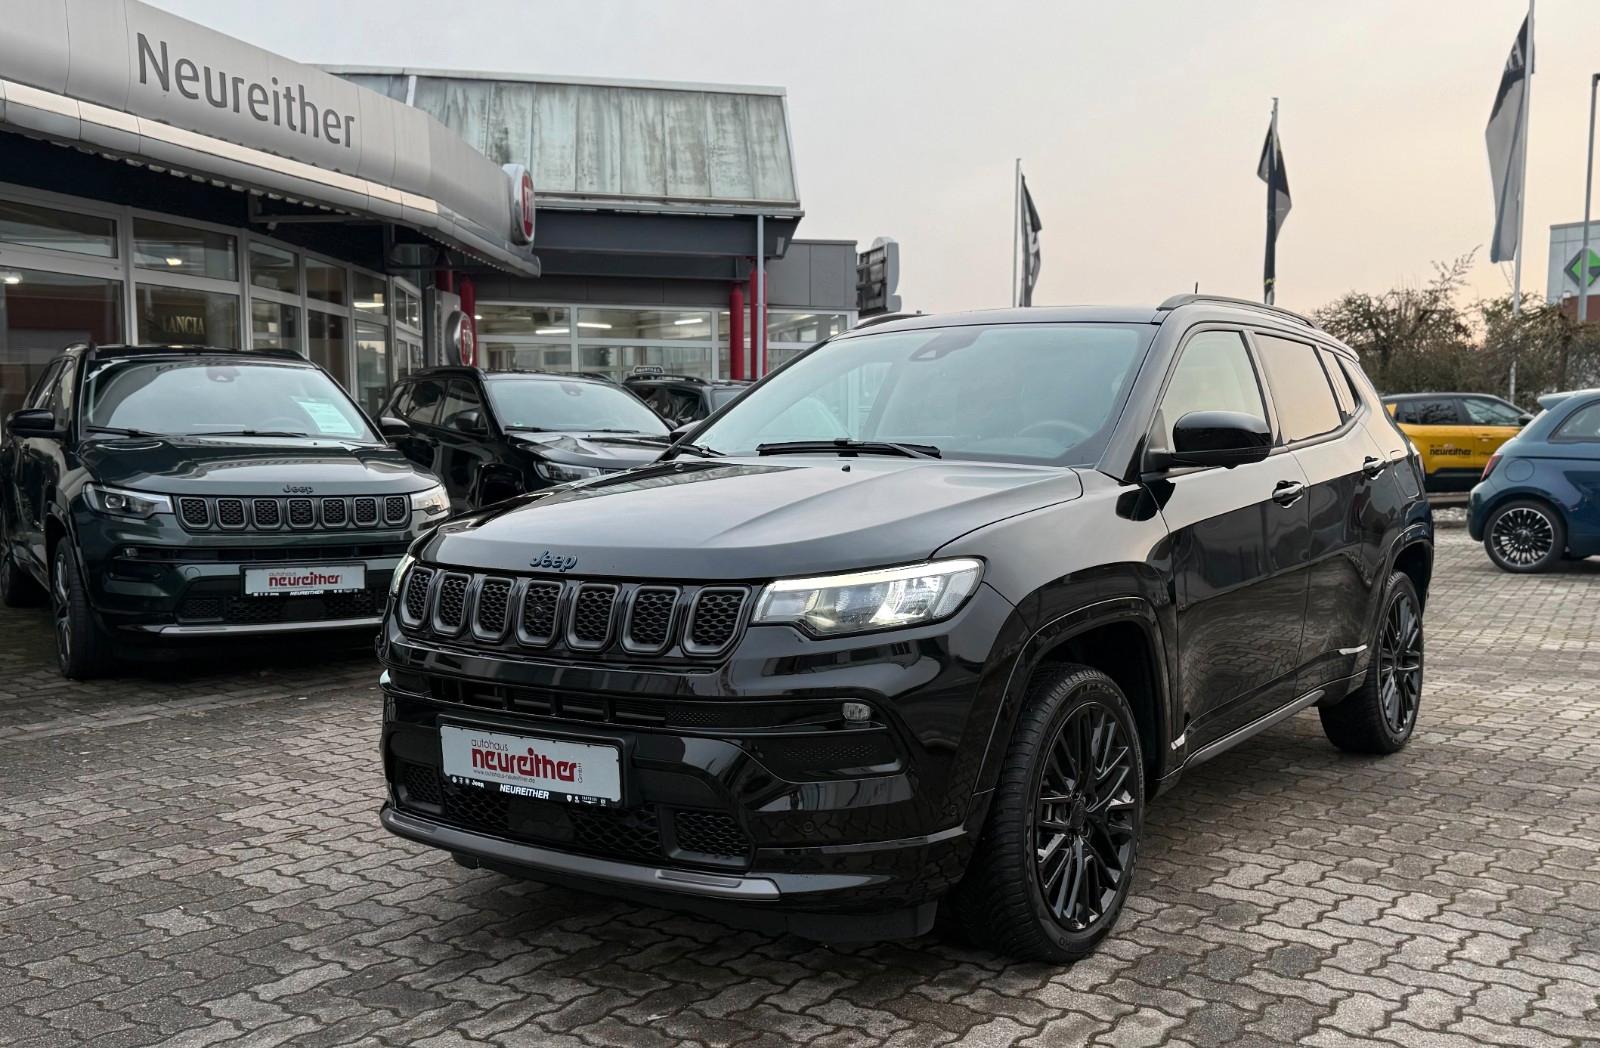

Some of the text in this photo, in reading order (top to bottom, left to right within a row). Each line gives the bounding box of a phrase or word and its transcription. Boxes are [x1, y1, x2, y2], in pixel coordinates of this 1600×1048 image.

[137, 32, 355, 148] Neureither
[282, 484, 314, 495] Jeep
[529, 550, 578, 572] Jeep
[269, 571, 340, 587] neureither
[471, 738, 509, 752] autohaus
[471, 747, 577, 782] neureither
[499, 783, 550, 801] NEUREITHER
